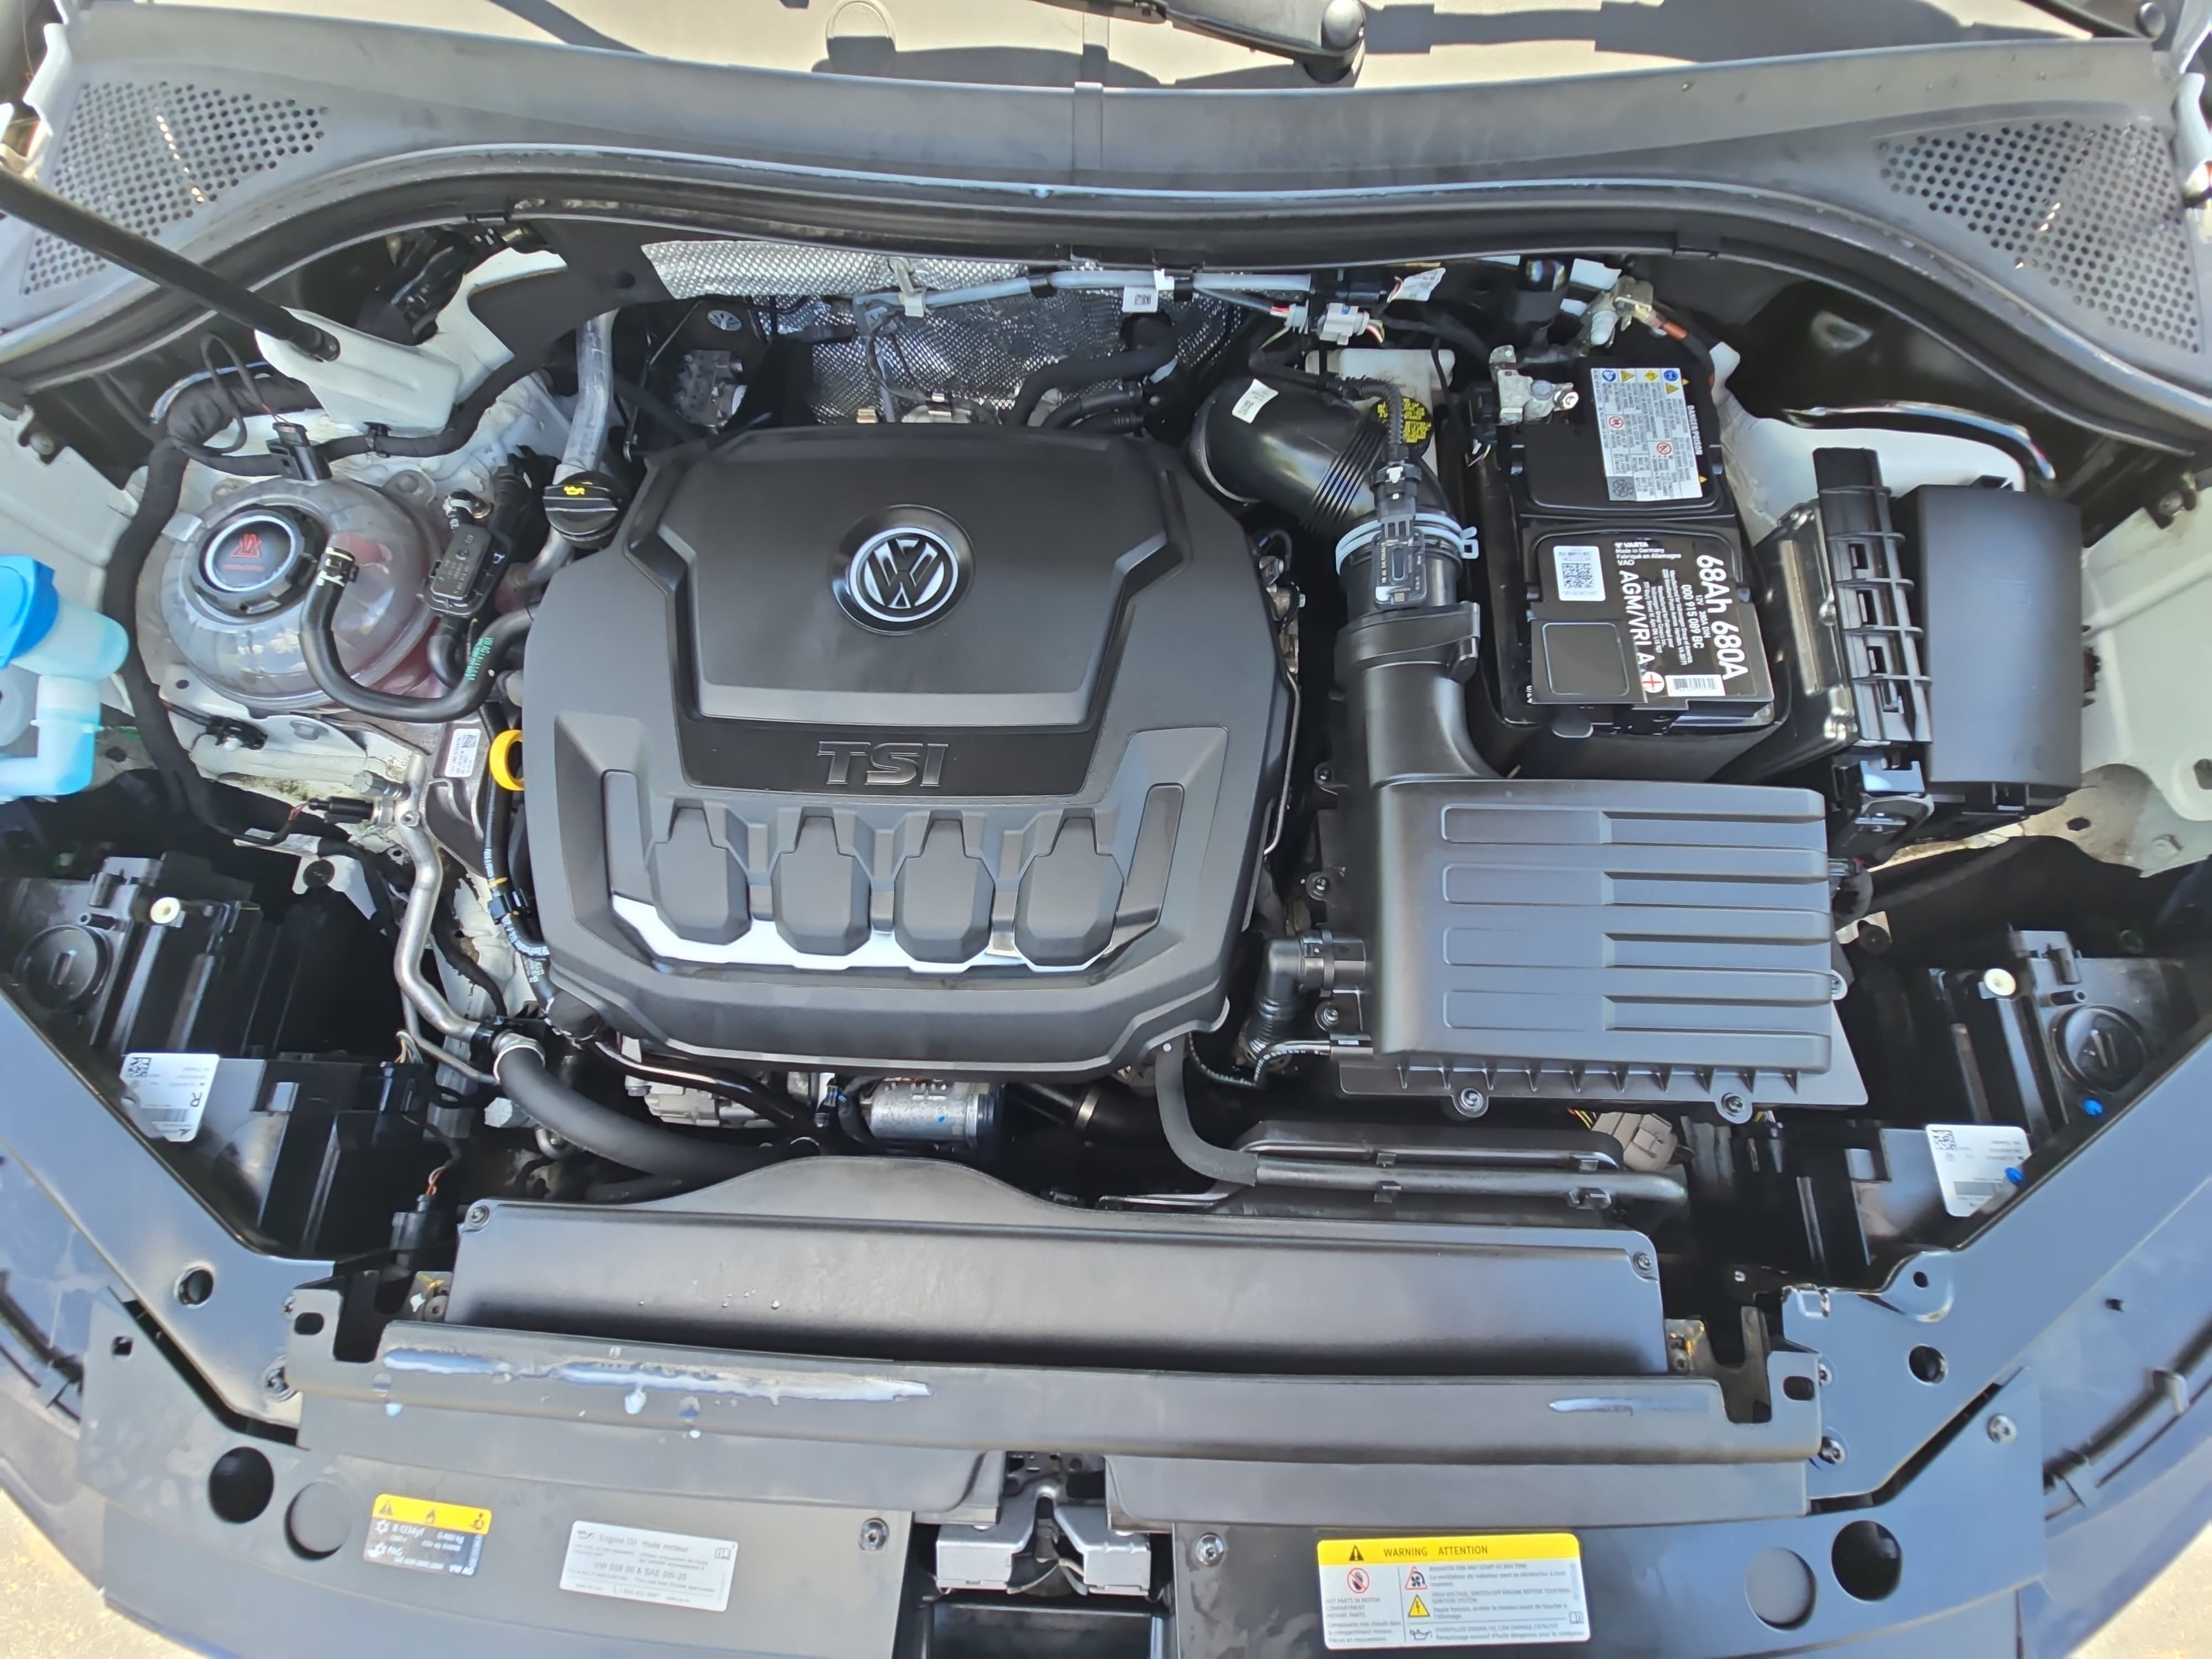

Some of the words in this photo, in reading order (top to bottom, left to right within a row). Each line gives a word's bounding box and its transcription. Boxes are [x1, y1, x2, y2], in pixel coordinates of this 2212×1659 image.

[1687, 405, 1703, 456] DANGER/POISON
[1670, 570, 1680, 597] Manufactured
[1681, 583, 1694, 601] 000
[1696, 555, 1733, 613] 68Ah
[1650, 586, 1660, 610] Volkswagen
[1655, 611, 1663, 623] Group
[1658, 585, 1668, 613] Manufactured
[1695, 594, 1704, 606] 12V
[1675, 603, 1686, 628] Volkswagen
[1684, 601, 1697, 618] 915
[1699, 610, 1708, 625] 380A
[1680, 628, 1689, 640] Group
[1688, 618, 1700, 634] 089
[1702, 626, 1711, 639] DIN
[1692, 635, 1704, 650] BC
[1711, 621, 1748, 680] 680A
[817, 741, 948, 786] TSI
[1384, 1547, 1428, 1557] WARNING
[1438, 1545, 1488, 1556] ATTENTION
